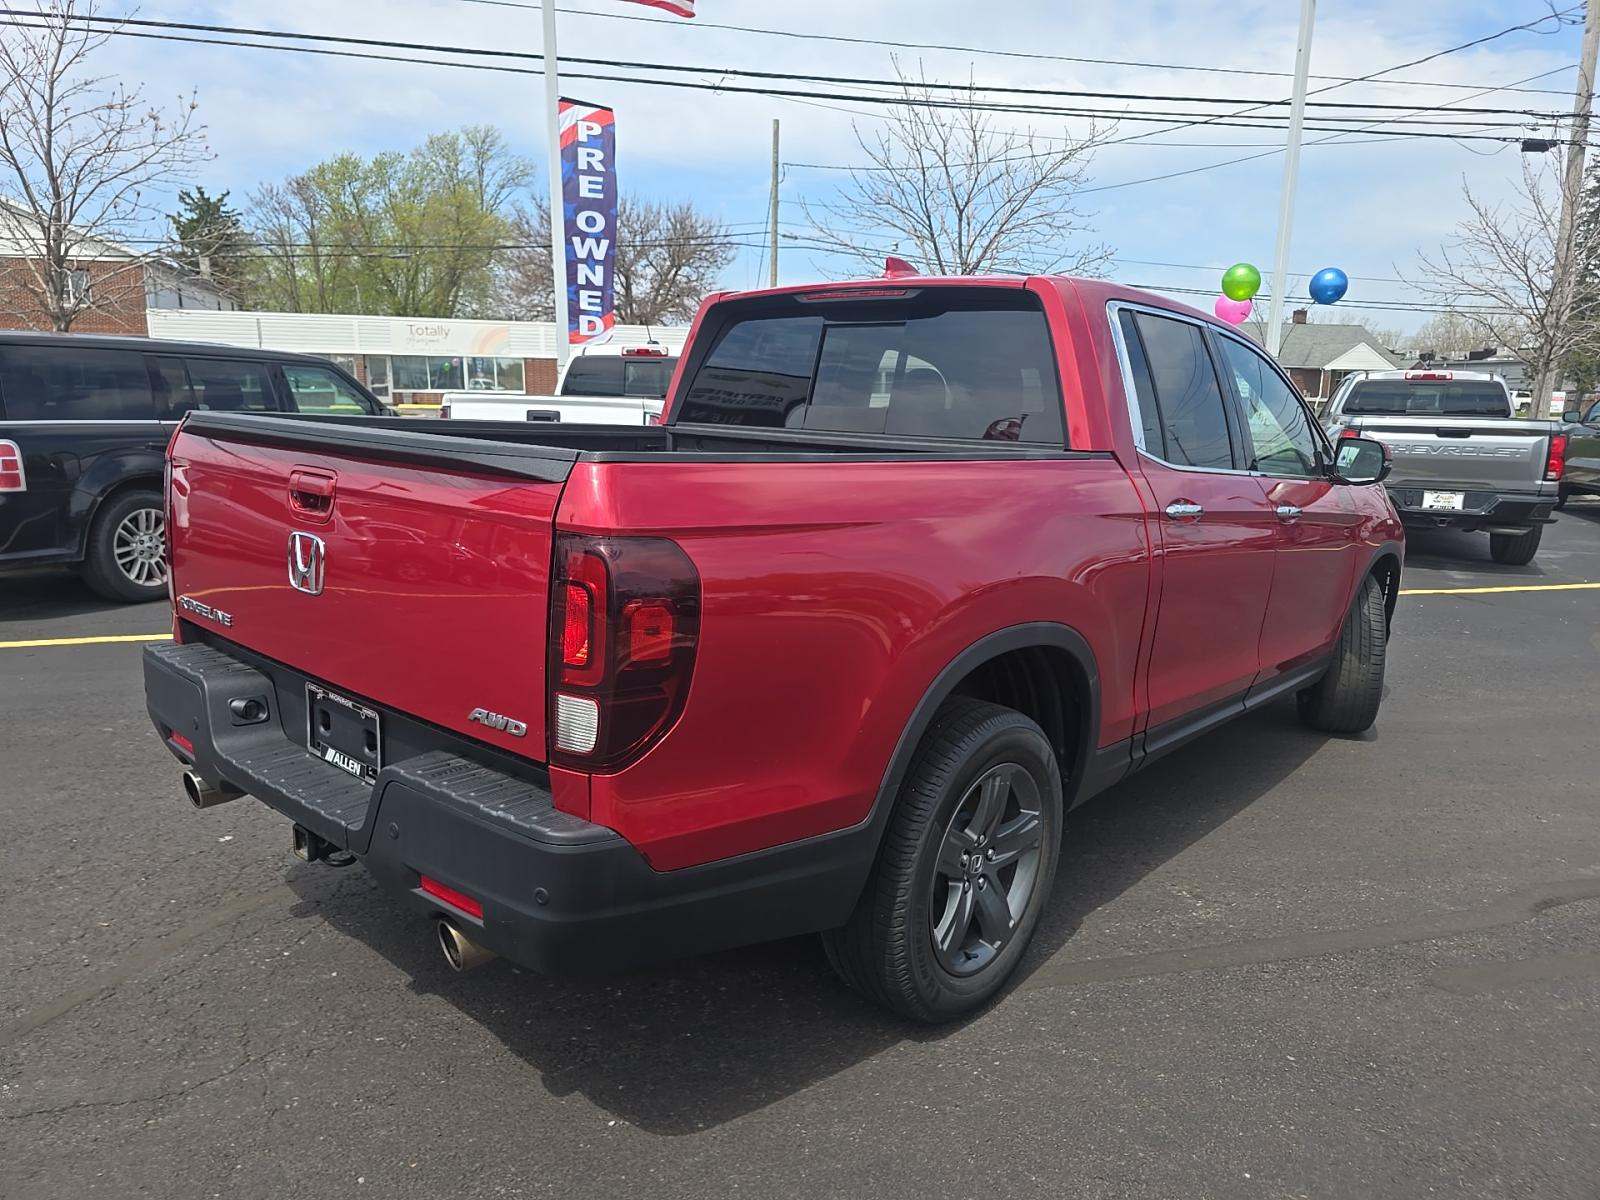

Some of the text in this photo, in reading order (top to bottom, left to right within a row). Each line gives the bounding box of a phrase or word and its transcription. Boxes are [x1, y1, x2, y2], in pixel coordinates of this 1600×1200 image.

[572, 120, 609, 336] PRE OWNED
[407, 324, 450, 338] Totally
[1390, 444, 1529, 457] HEVROLET
[468, 707, 528, 737] AWD
[333, 752, 361, 776] ALLEN
